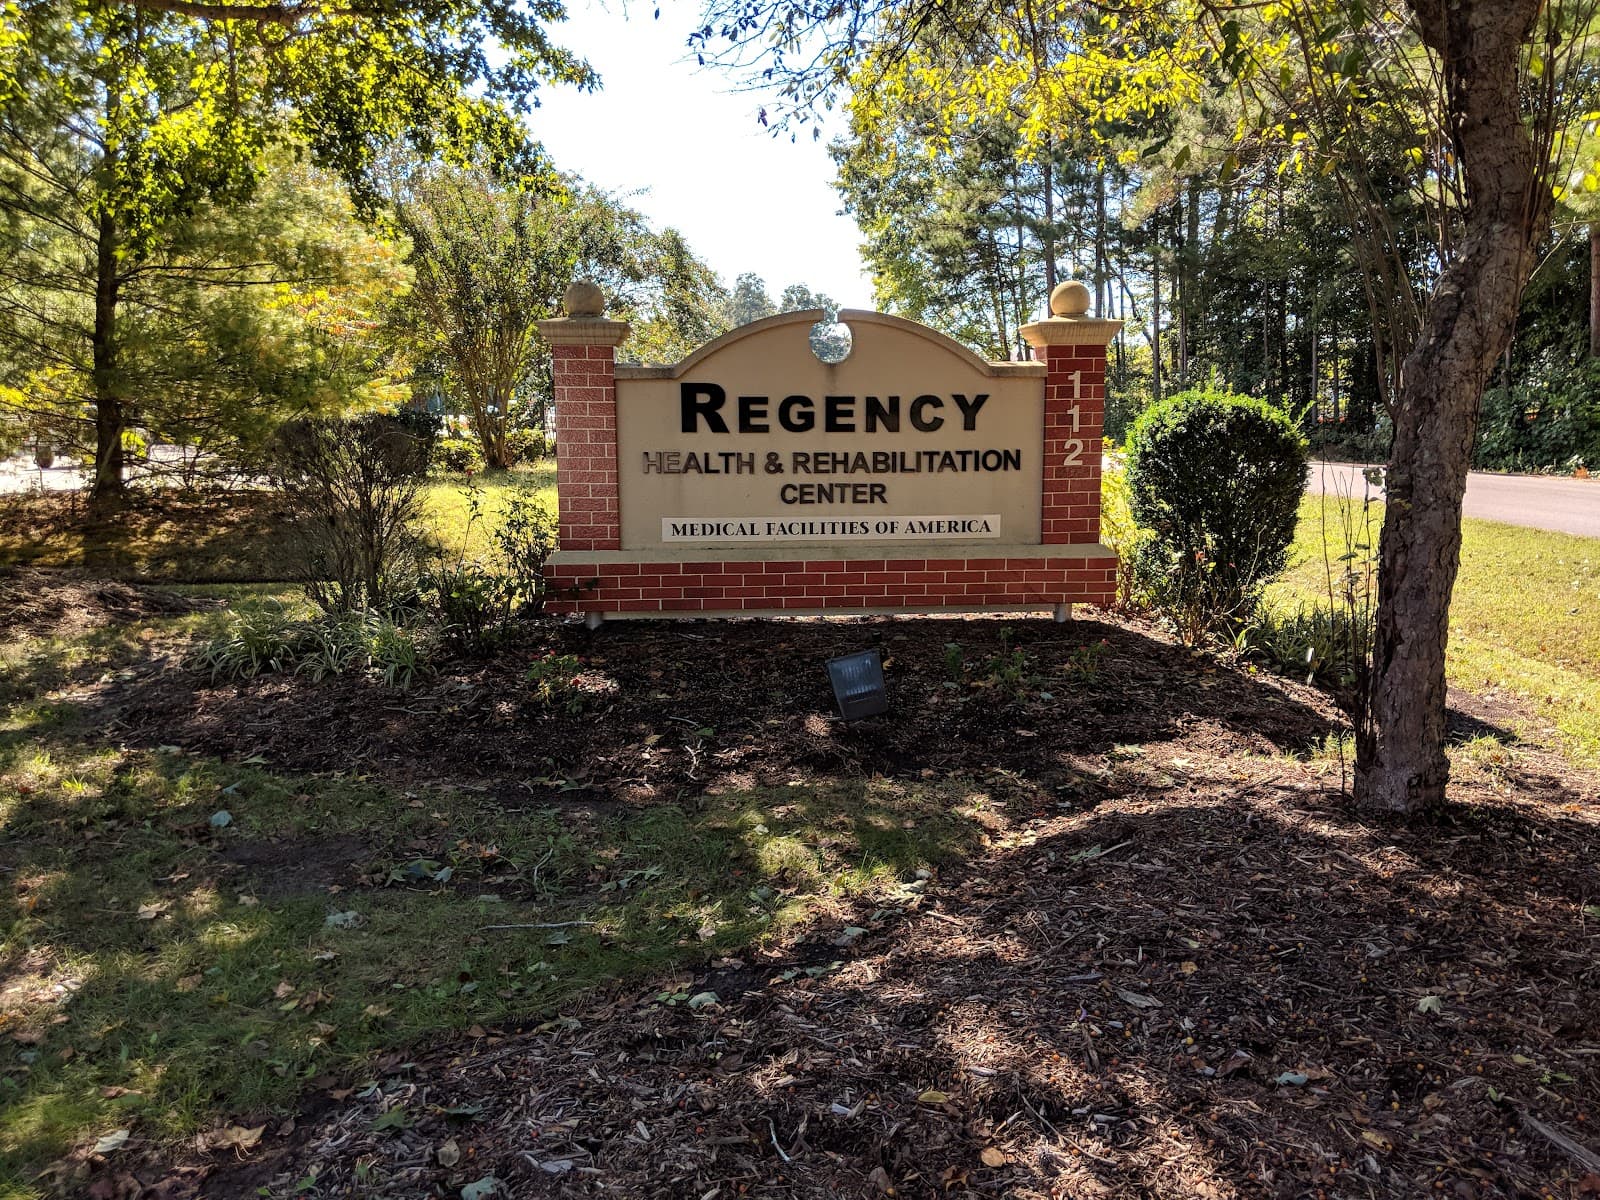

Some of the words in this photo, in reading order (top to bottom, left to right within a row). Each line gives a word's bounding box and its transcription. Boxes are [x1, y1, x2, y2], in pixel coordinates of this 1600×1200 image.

[681, 382, 989, 433] REGENCY
[643, 451, 754, 474] HEALTH
[764, 452, 784, 474] &
[792, 449, 1020, 474] REHABILITATION
[780, 482, 888, 505] CENTER
[671, 523, 760, 536] MEDICAL
[766, 521, 869, 536] FACILITIES
[875, 520, 899, 534] OF
[904, 519, 992, 534] AMERICA
